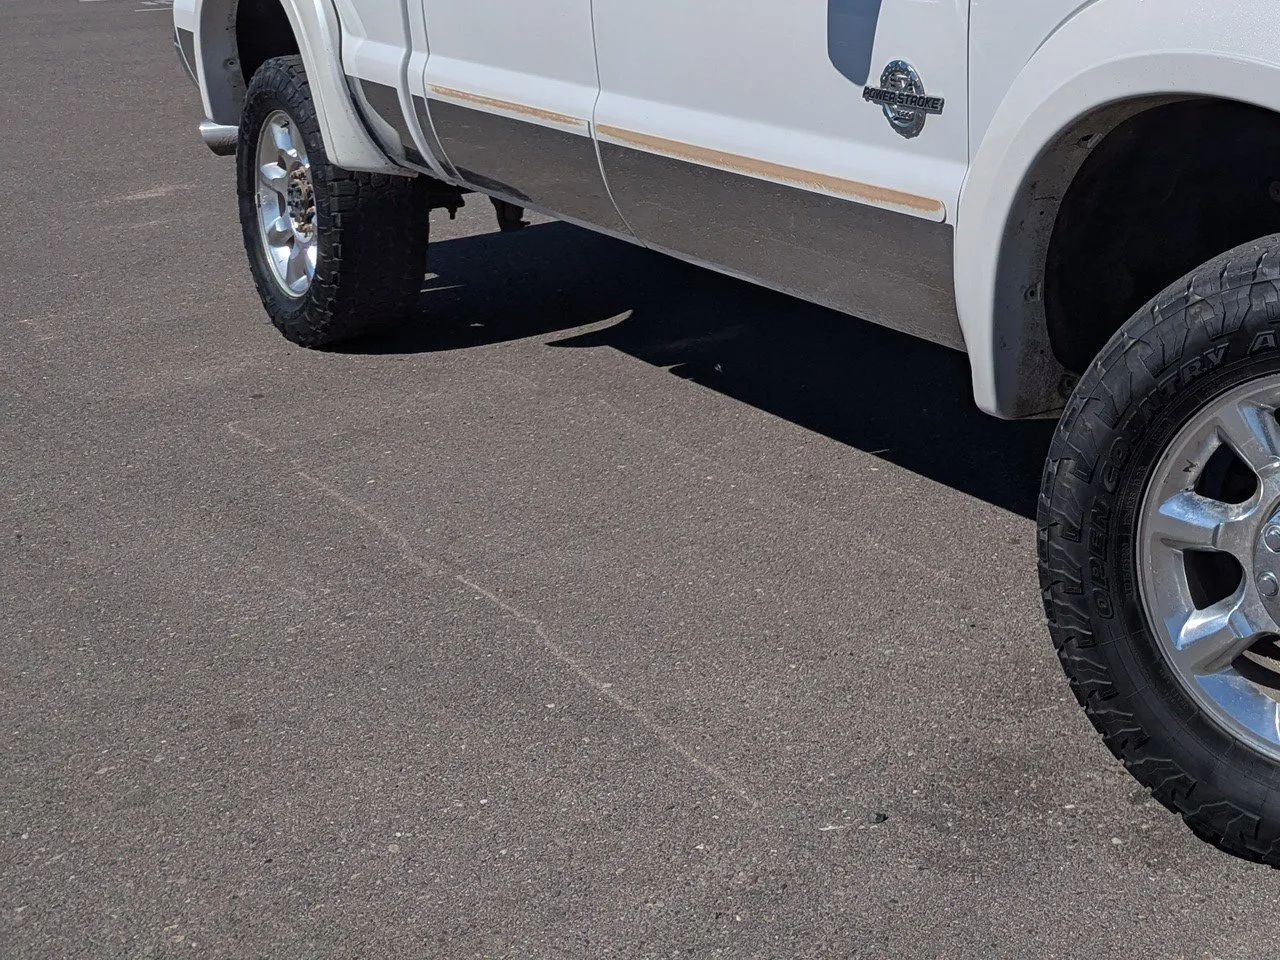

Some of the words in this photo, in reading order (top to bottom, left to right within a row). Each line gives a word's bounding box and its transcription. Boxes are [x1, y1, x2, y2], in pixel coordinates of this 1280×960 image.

[862, 86, 896, 103] POWER
[897, 93, 941, 109] STROKE
[1088, 495, 1114, 619] OPEN
